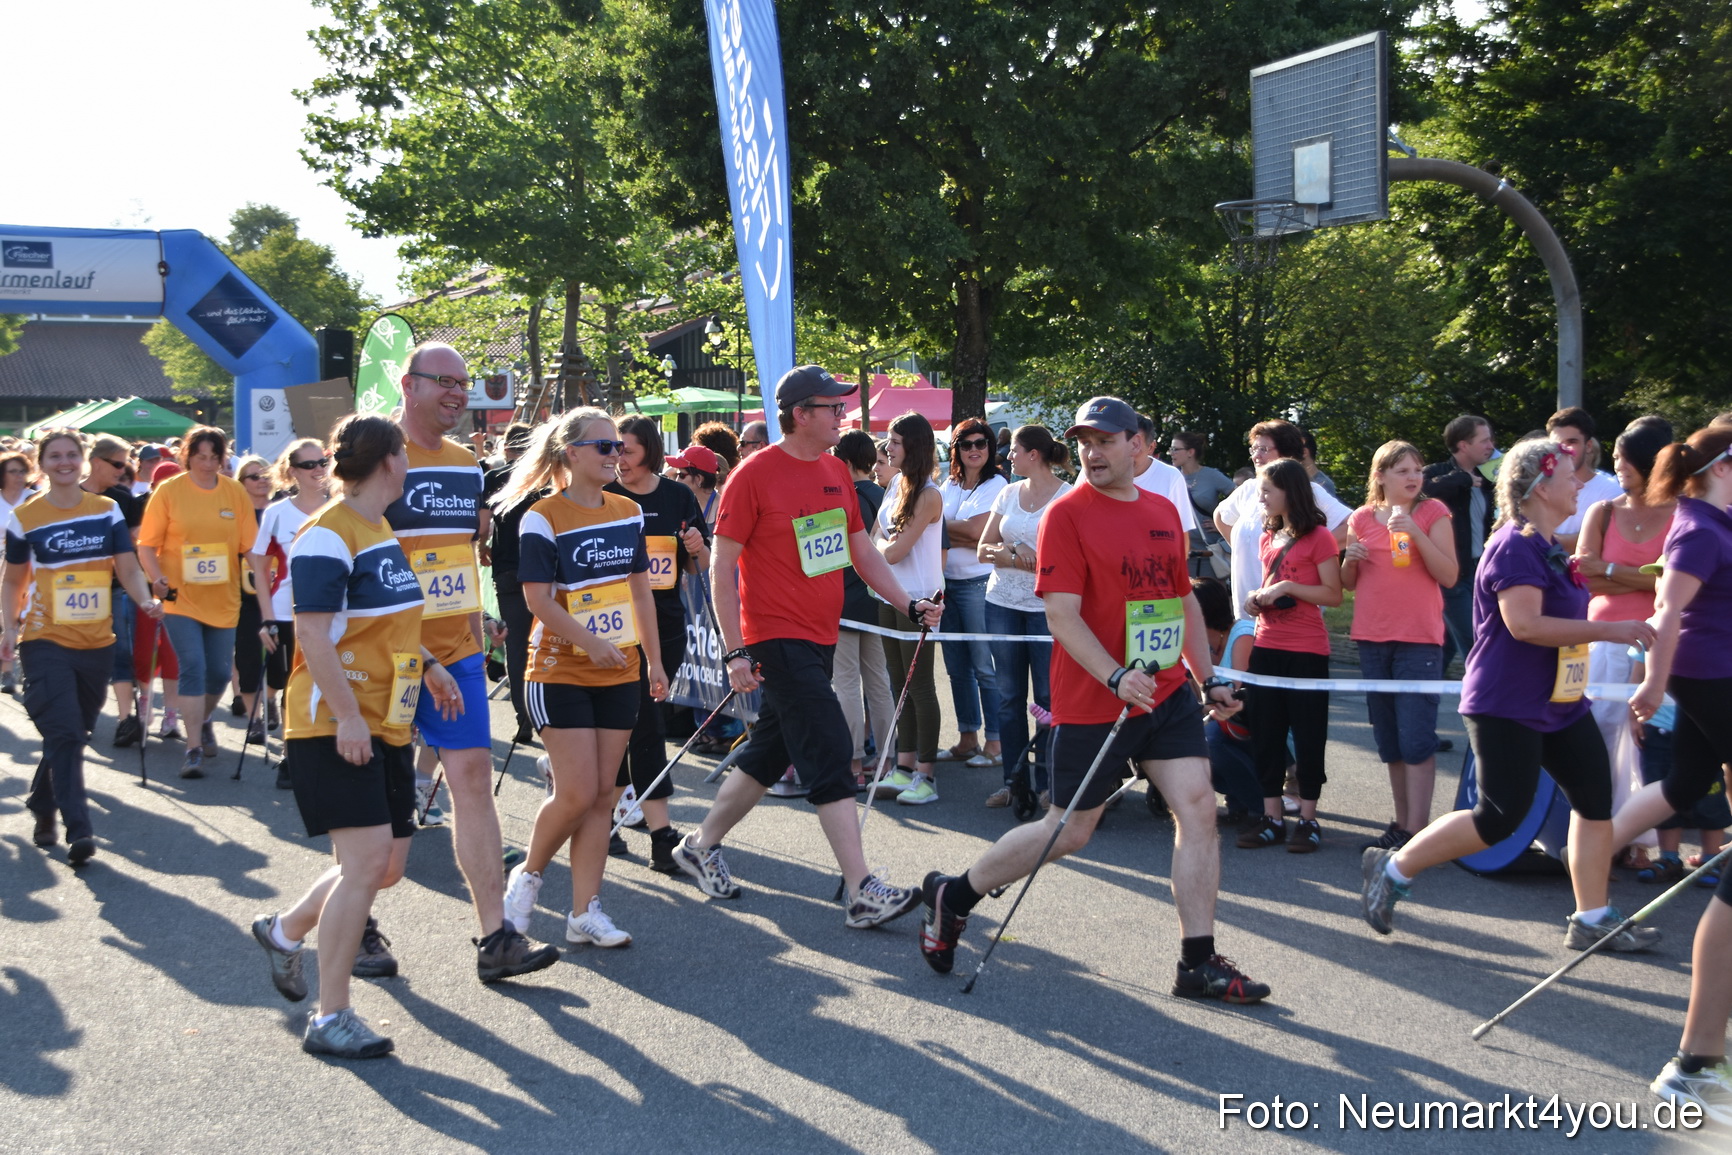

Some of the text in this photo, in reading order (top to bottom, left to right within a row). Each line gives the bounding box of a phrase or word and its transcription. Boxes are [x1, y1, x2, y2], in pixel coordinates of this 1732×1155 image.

[0, 270, 96, 290] rmenlauf
[373, 317, 401, 346] OK
[423, 494, 476, 509] Fischer
[430, 509, 477, 517] AUTOMOBILE
[57, 535, 106, 549] Fischer
[63, 544, 103, 553] AUTOMOBILE
[804, 532, 844, 560] 1522
[587, 545, 635, 562] Fischer
[197, 559, 217, 574] 65
[648, 557, 672, 575] 02
[387, 568, 416, 585] Fische
[427, 572, 466, 598] 434
[65, 591, 99, 609] 401
[586, 610, 624, 635] 436
[1135, 624, 1180, 652] 1521
[1565, 662, 1585, 684] 708
